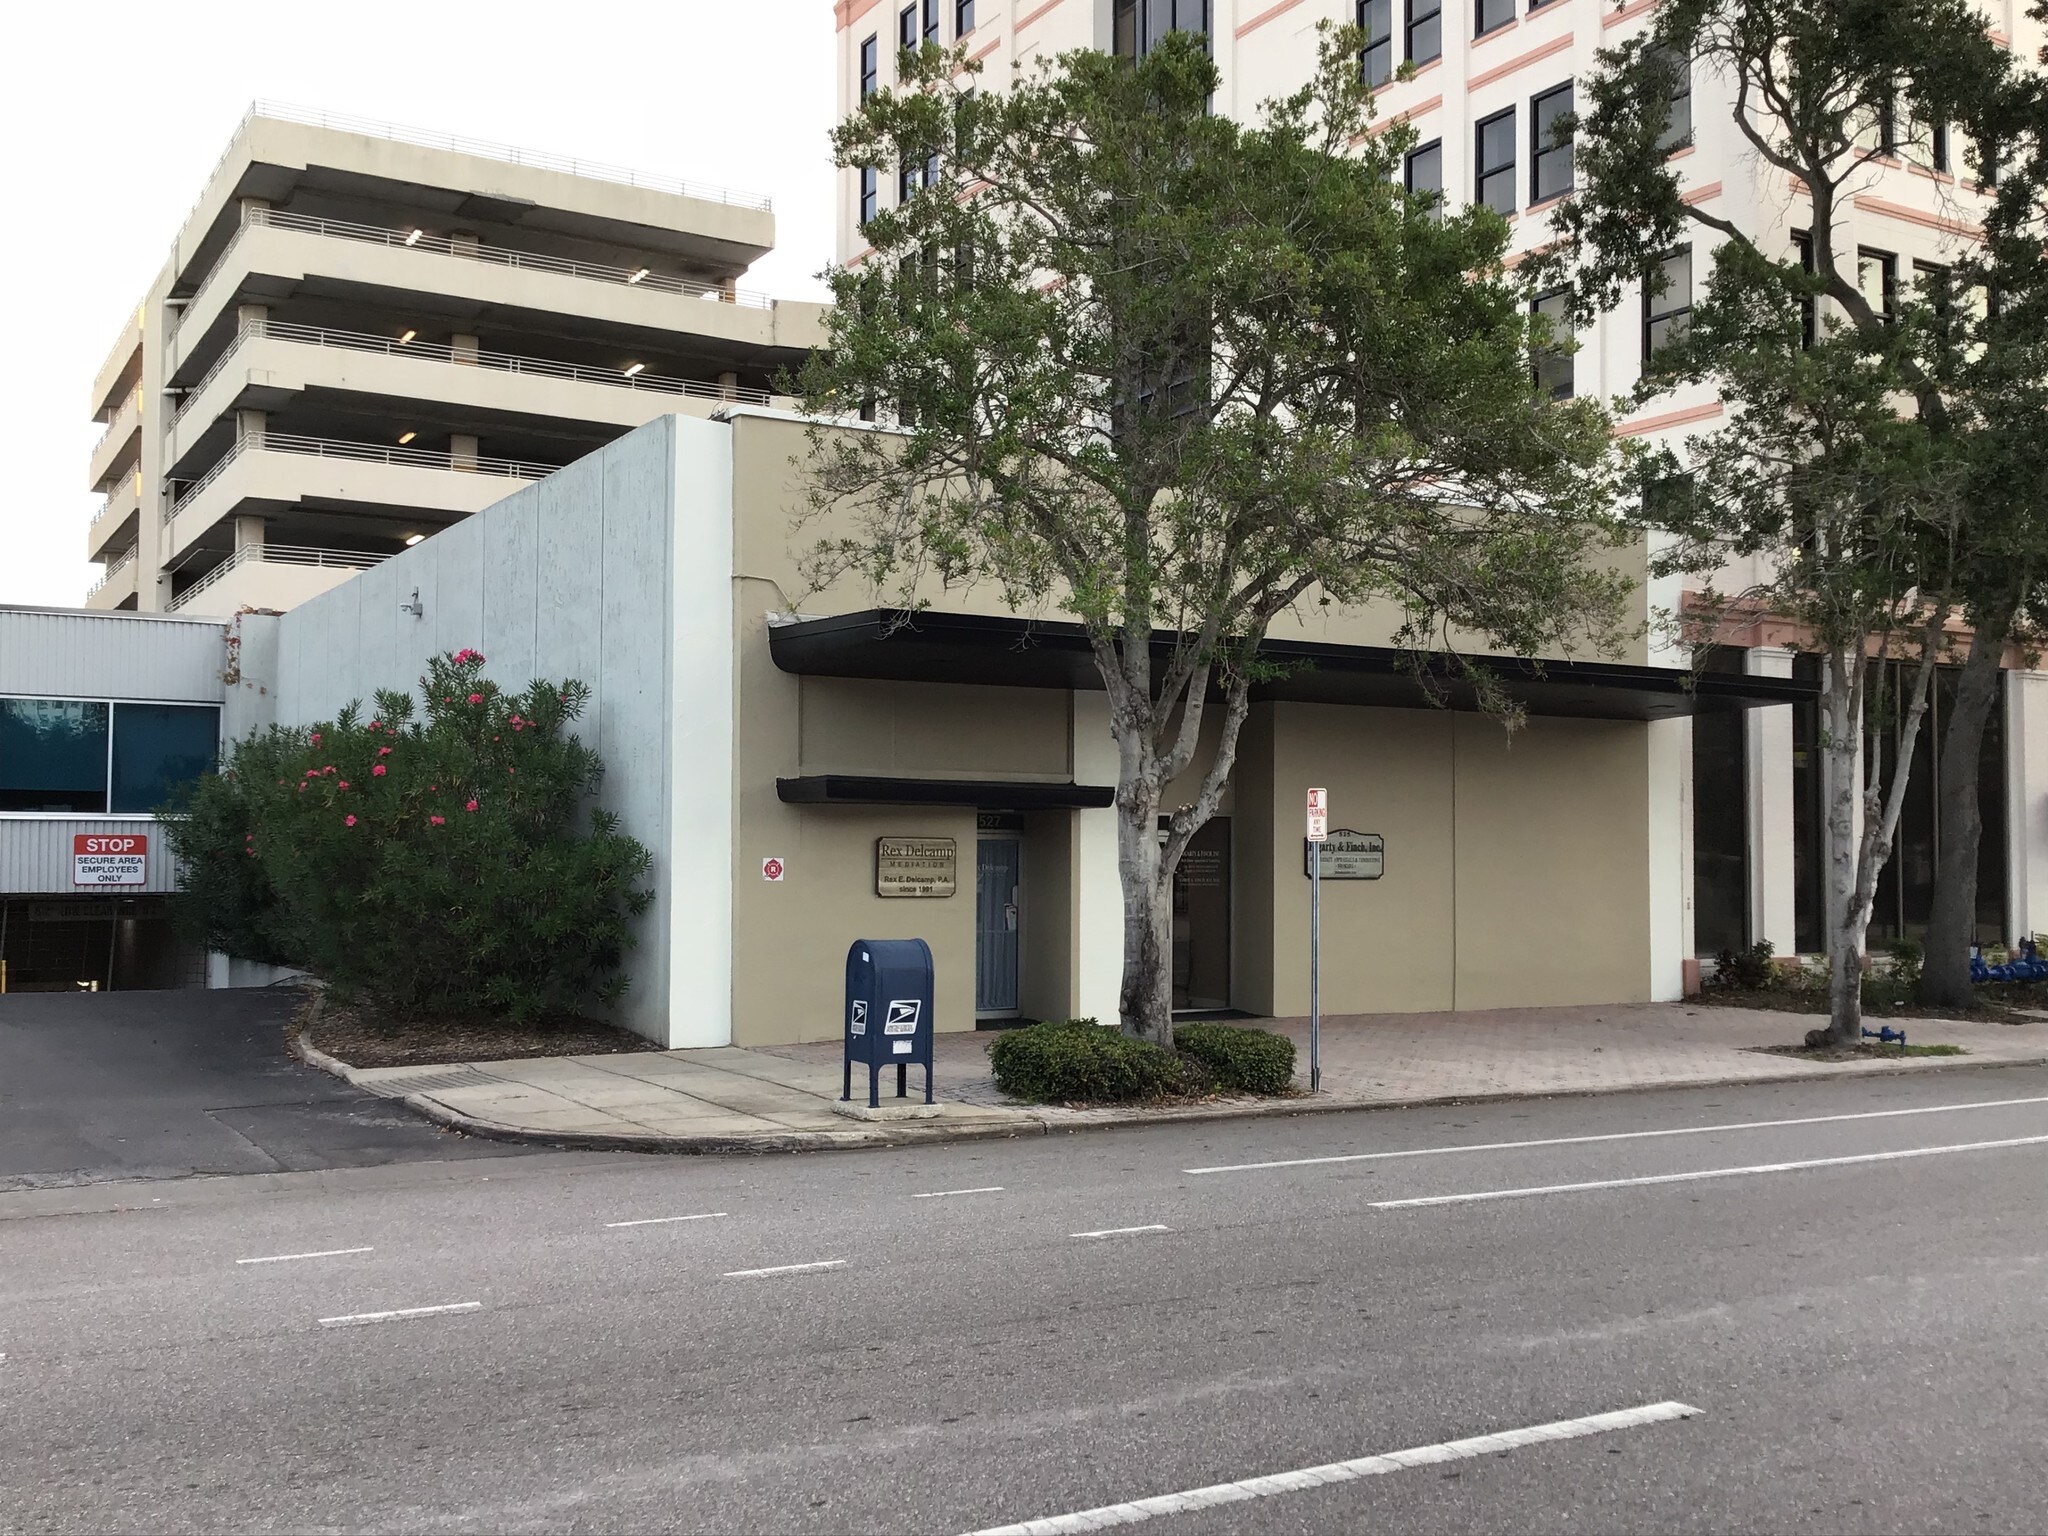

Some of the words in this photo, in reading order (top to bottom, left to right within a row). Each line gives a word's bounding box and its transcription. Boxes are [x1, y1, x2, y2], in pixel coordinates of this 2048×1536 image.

[1309, 792, 1318, 806] NO
[1309, 808, 1326, 817] PARKING
[979, 815, 1000, 827] 527
[86, 838, 135, 852] STOP
[1309, 842, 1336, 855] Fgarty
[1338, 842, 1345, 852] &
[881, 844, 903, 857] Rex
[905, 844, 954, 860] Delcamp
[884, 875, 898, 883] Rex
